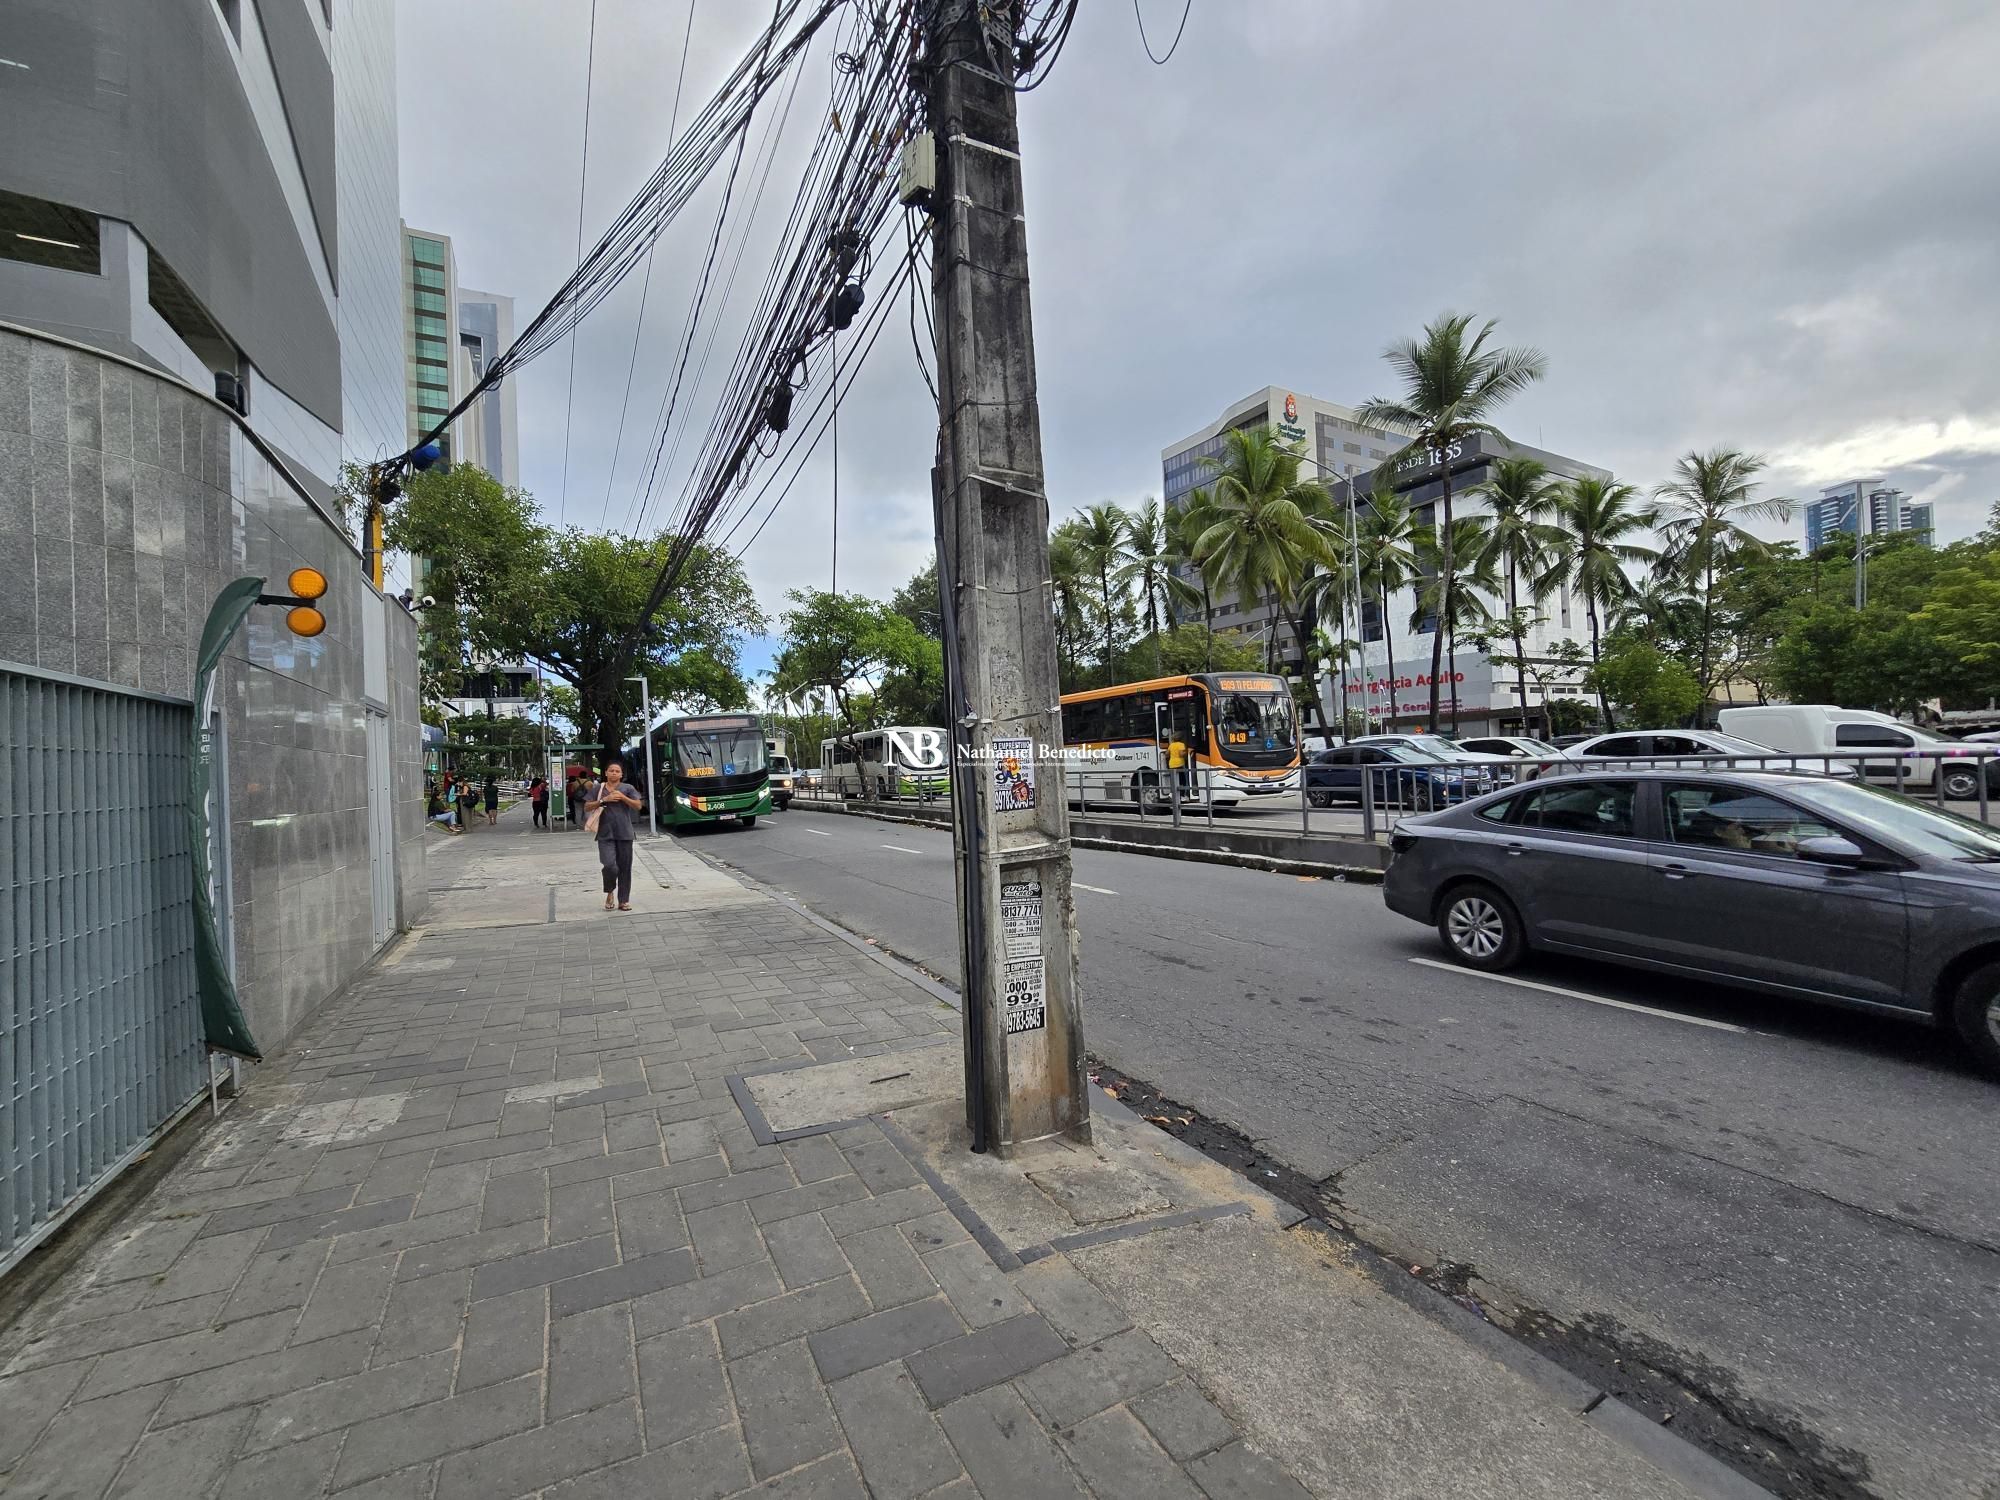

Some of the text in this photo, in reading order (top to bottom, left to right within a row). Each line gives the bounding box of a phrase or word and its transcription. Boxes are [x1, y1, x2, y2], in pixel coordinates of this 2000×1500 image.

[1403, 701, 1431, 713] Geral
[707, 803, 725, 811] 2.408
[1003, 885, 1030, 893] GUGA
